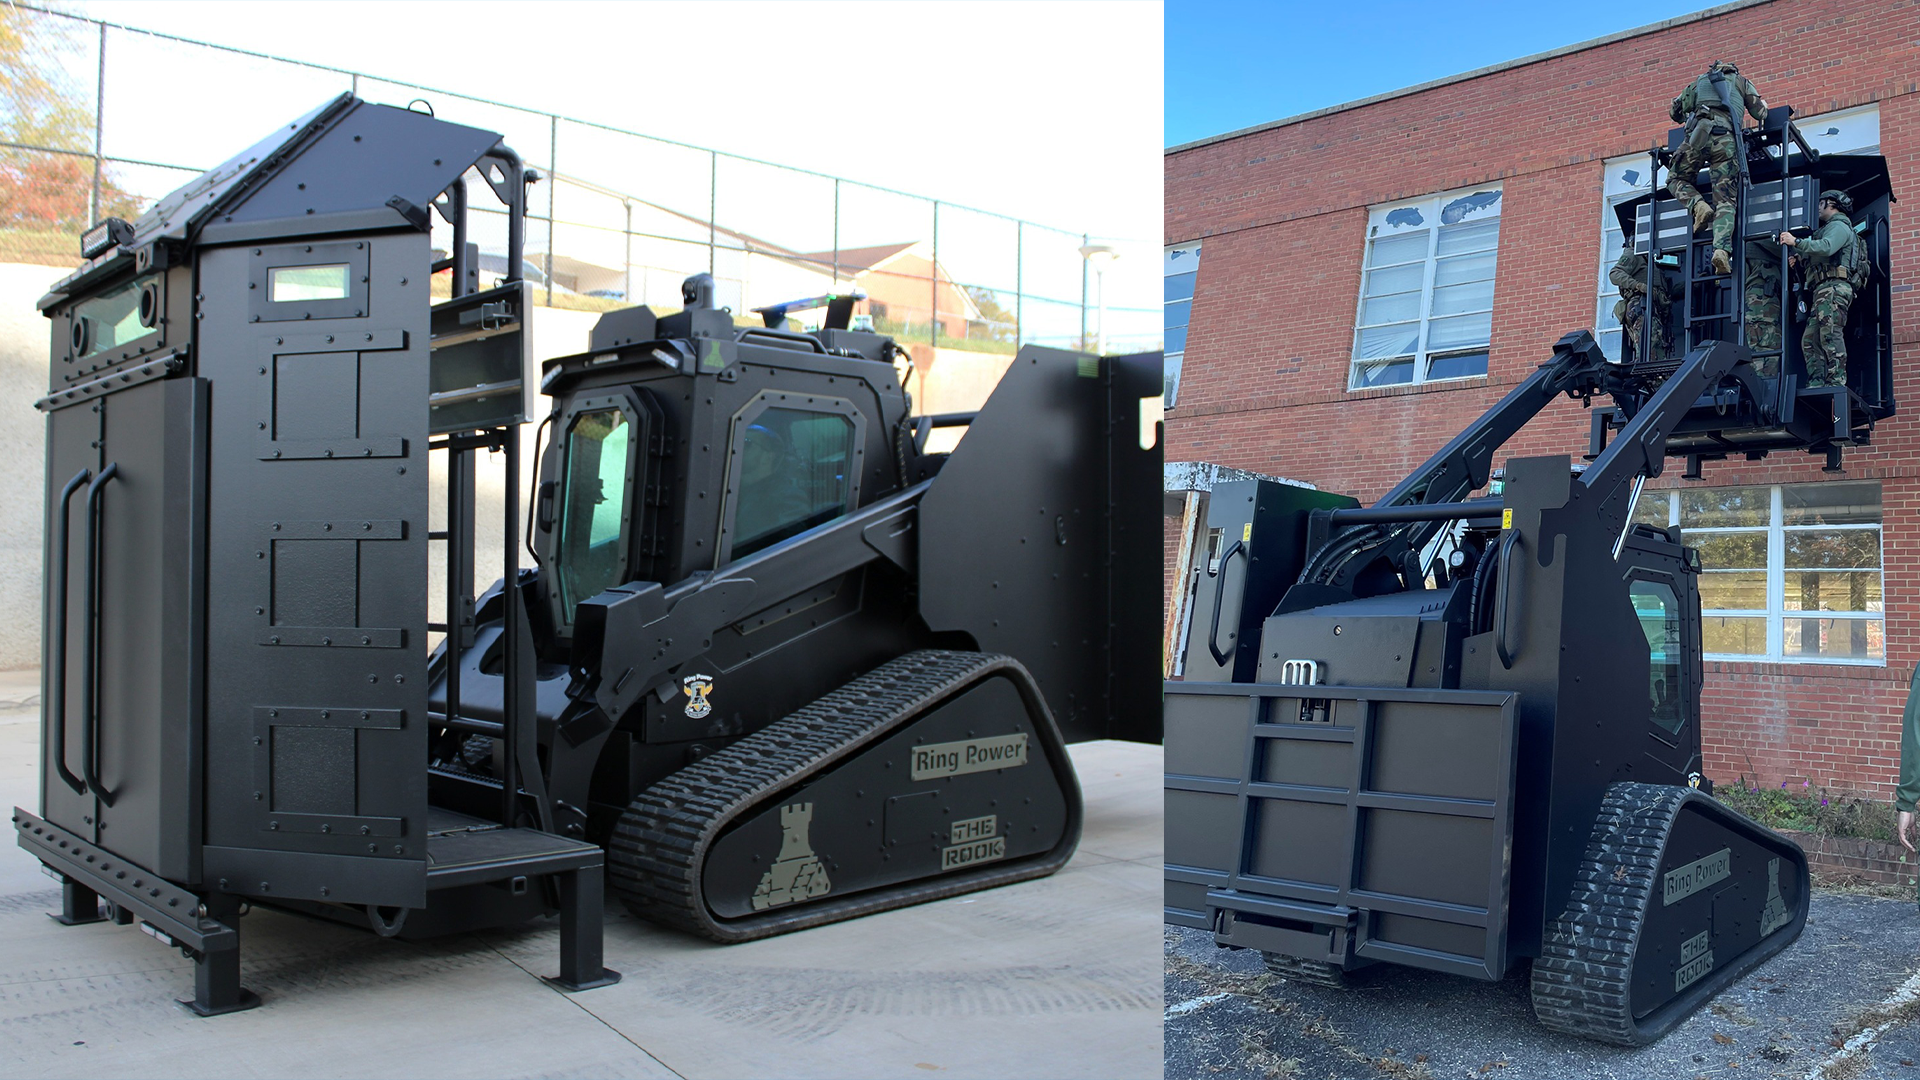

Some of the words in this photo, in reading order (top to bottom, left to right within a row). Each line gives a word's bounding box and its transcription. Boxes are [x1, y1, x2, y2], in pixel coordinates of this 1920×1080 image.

[916, 749, 959, 772] Ring
[966, 744, 1022, 764] Power
[953, 818, 994, 840] THE
[946, 841, 1001, 866] ROOK
[1667, 872, 1692, 896] Ring
[1695, 858, 1728, 883] Power
[1683, 934, 1707, 957] THE
[1678, 954, 1711, 987] ROOK
